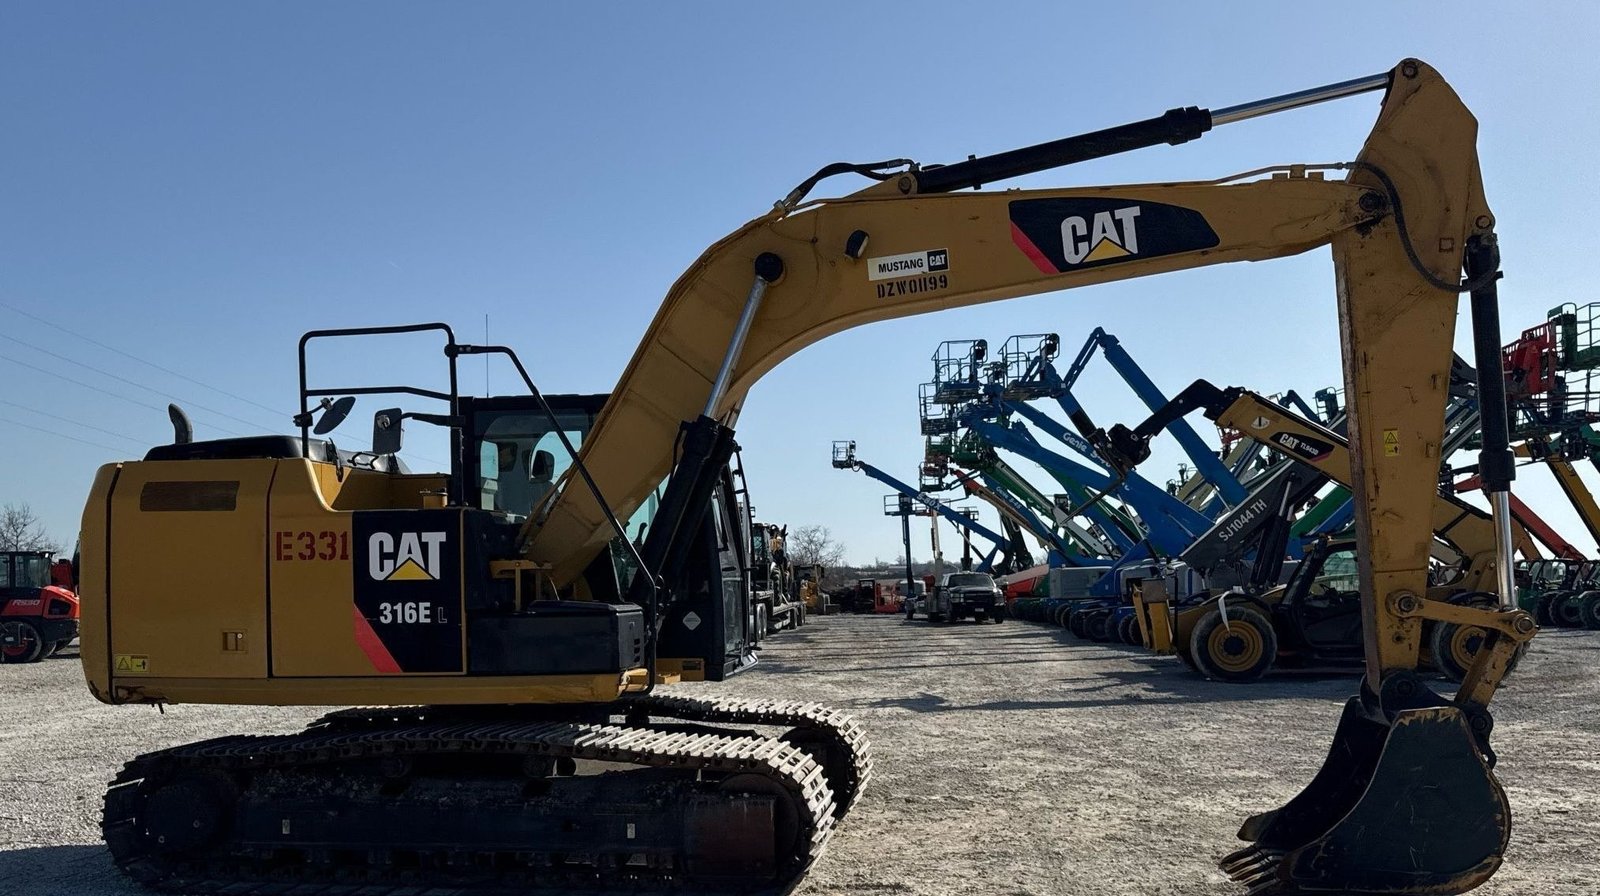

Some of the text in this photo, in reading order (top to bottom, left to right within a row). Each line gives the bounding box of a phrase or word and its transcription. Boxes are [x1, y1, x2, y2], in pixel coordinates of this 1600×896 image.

[1061, 206, 1141, 264] CAT
[878, 254, 946, 273] MUSTANG CAT
[877, 274, 948, 298] DZW01199
[1063, 432, 1088, 452] Genie
[1279, 433, 1300, 449] CAT
[1218, 499, 1267, 541] SJ1044 TH
[275, 531, 349, 561] E331
[369, 531, 446, 581] CAT
[379, 602, 448, 624] 316E L
